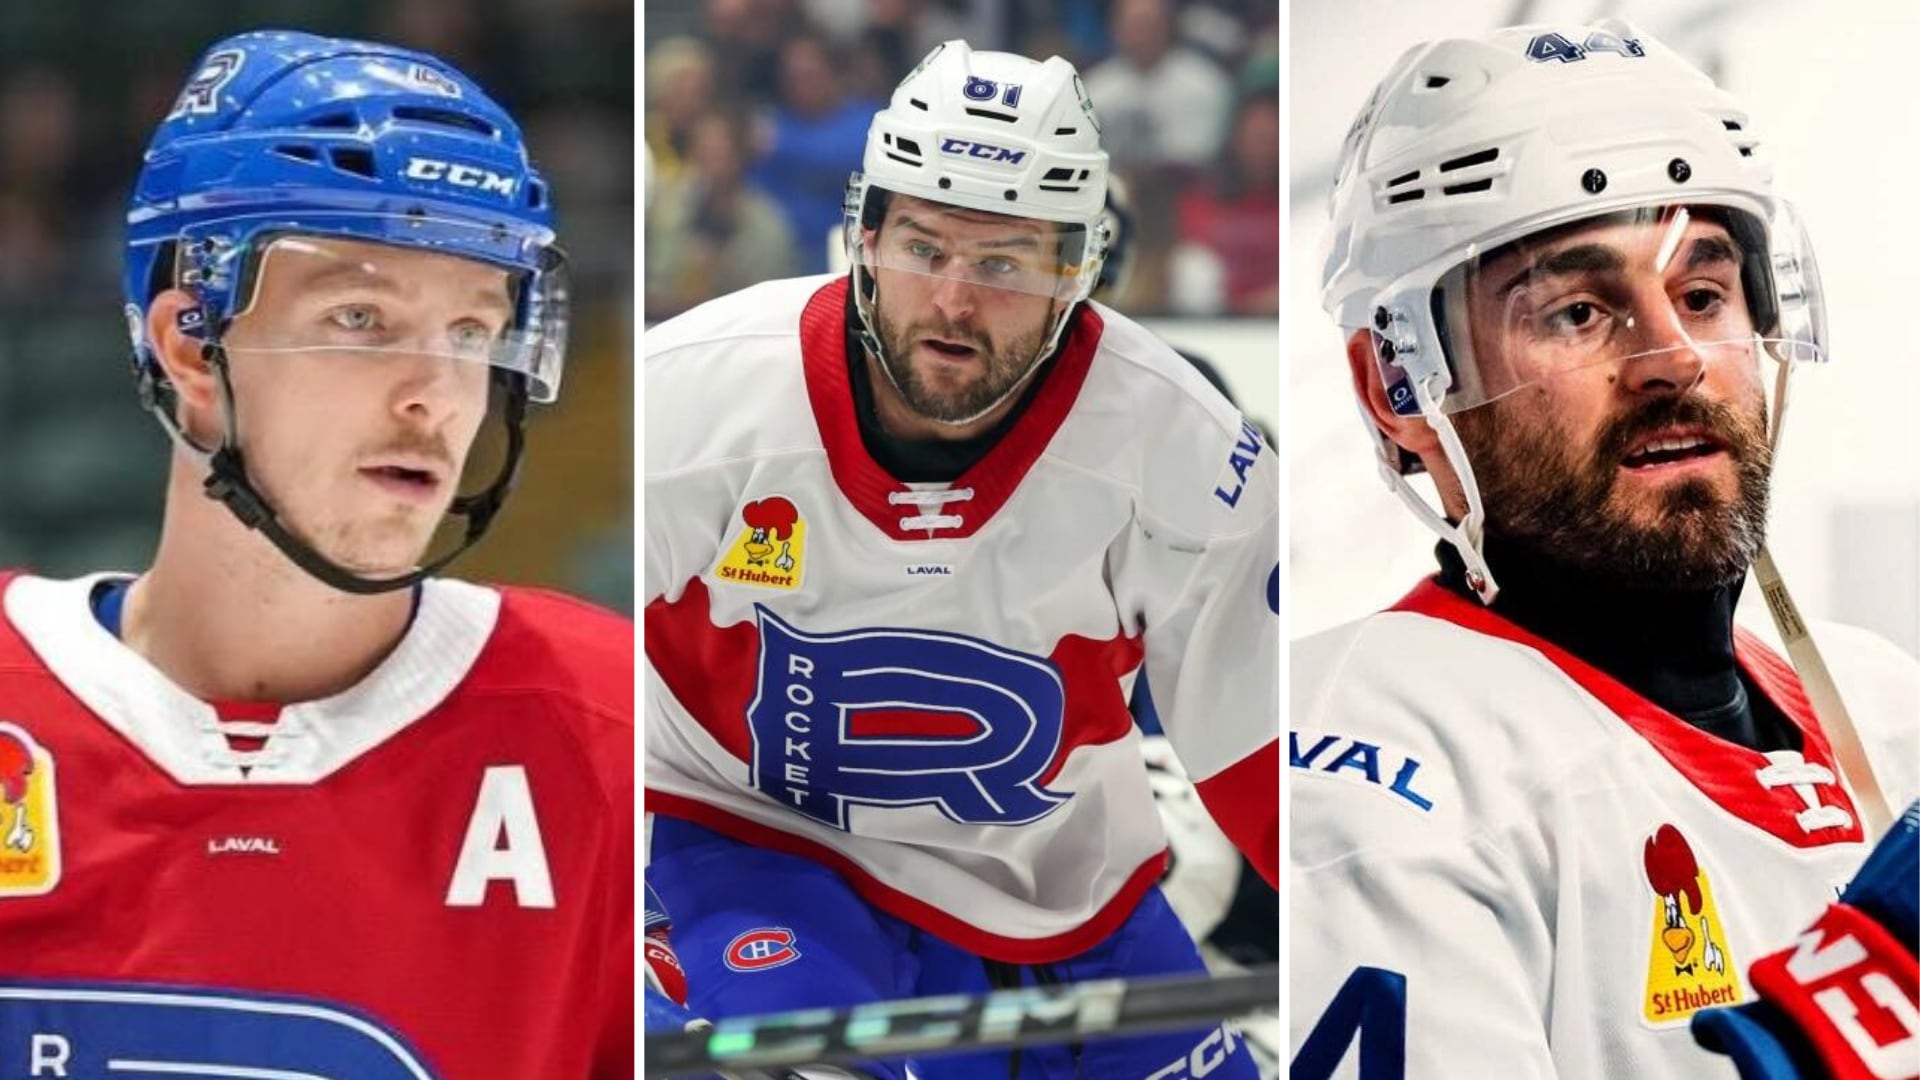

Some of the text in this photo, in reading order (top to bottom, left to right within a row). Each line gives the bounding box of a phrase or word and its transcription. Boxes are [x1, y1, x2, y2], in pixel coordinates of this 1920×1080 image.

[1525, 32, 1646, 64] 44
[963, 75, 1023, 109] 81
[941, 138, 1026, 165] CCM
[405, 157, 517, 195] CCM
[738, 569, 792, 586] Hubert
[907, 566, 952, 575] LAVAL
[784, 653, 815, 806] ROCKET
[207, 837, 280, 854] LAVAL
[444, 765, 557, 909] A
[1675, 984, 1737, 1013] Hubert
[707, 981, 1127, 1061] CCM
